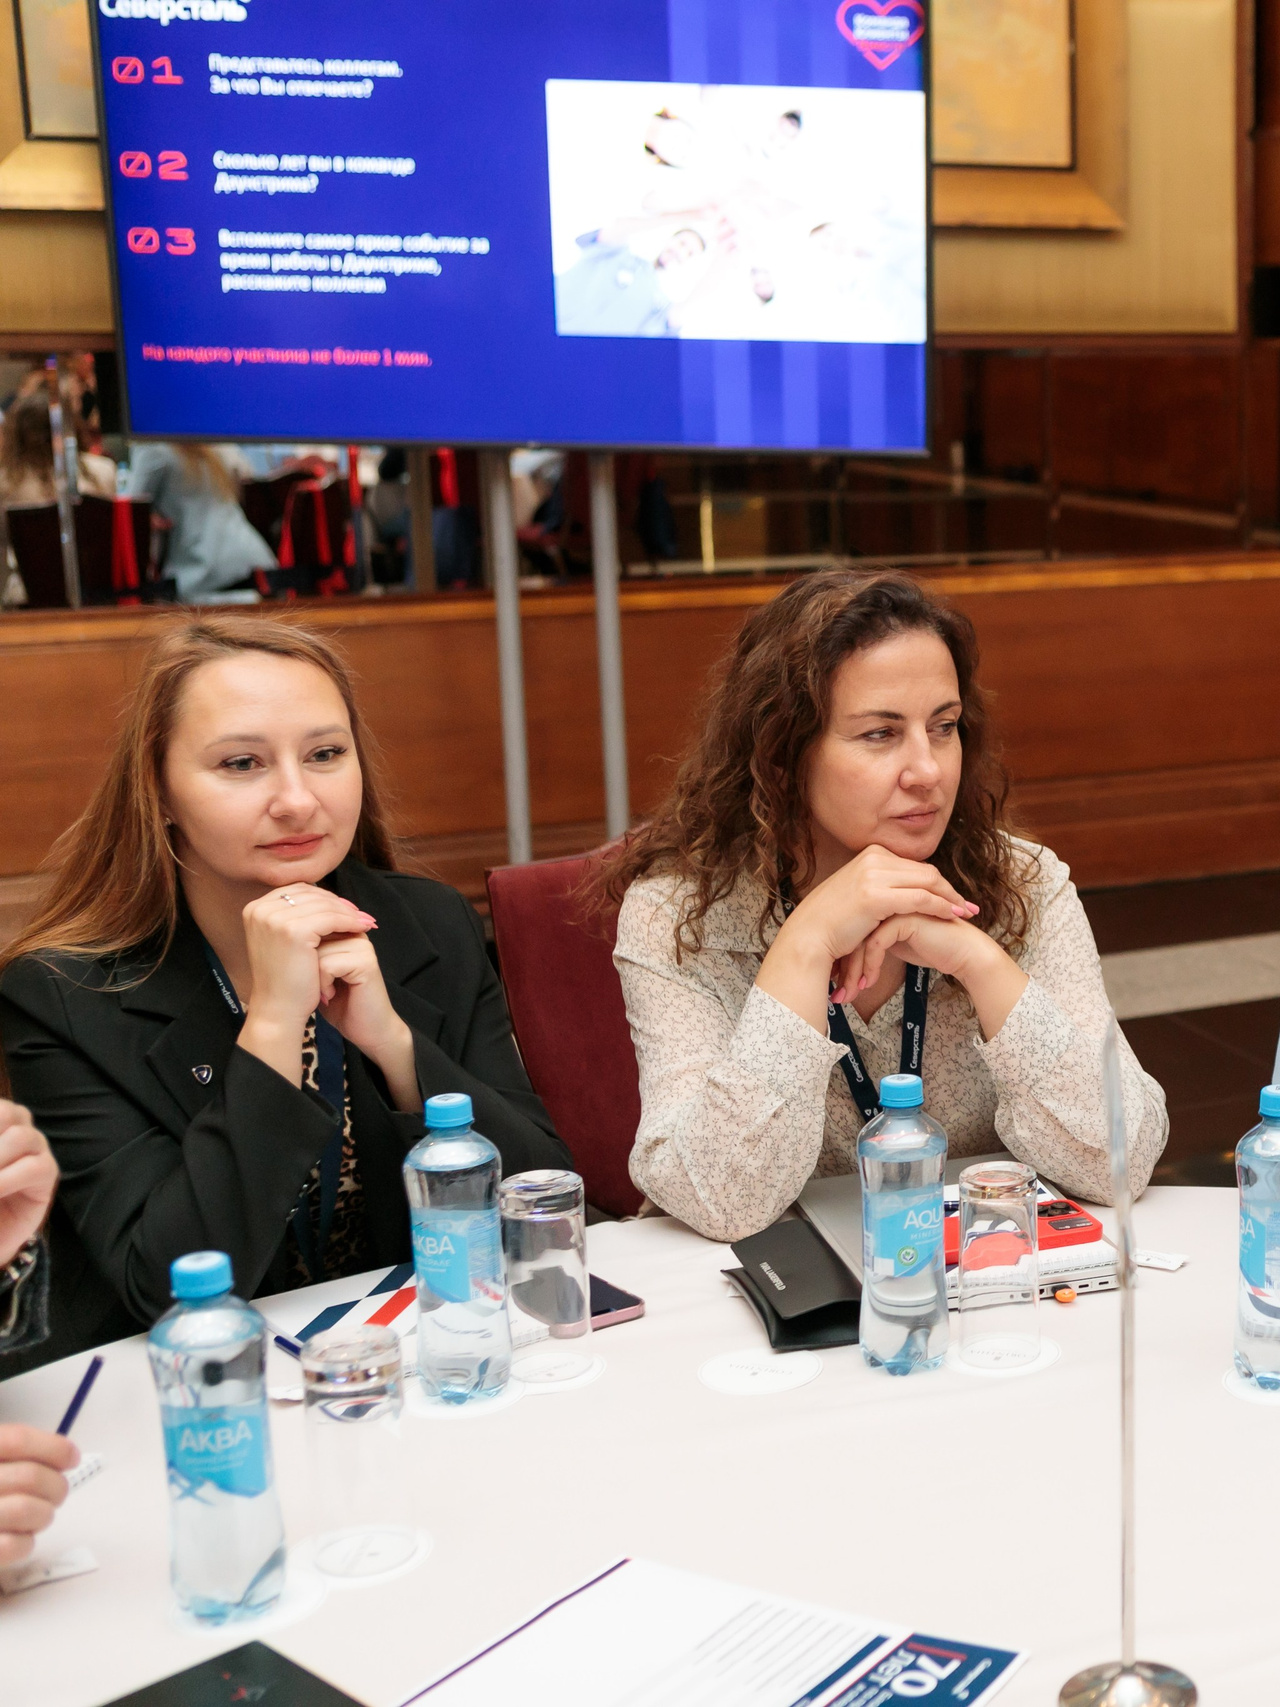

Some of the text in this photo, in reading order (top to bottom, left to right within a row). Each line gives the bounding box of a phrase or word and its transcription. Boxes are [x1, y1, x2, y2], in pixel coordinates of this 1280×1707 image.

[111, 56, 183, 84] 01
[231, 78, 260, 95] что
[119, 150, 189, 180] 02
[213, 150, 279, 170] Сколько
[279, 154, 308, 172] лет
[345, 156, 416, 177] команде
[127, 226, 196, 255] 03
[304, 233, 355, 250] самое
[355, 234, 403, 254] яркое
[403, 233, 469, 254] событие
[220, 252, 270, 272] время
[271, 251, 330, 273] работы
[142, 343, 165, 361] На
[166, 346, 232, 363] каждого
[232, 347, 310, 366] участника
[311, 349, 332, 365] не
[332, 346, 381, 366] более
[382, 347, 393, 367] 1
[909, 1024, 921, 1070] Северсталь
[180, 1420, 253, 1453] АКВА
[890, 1653, 962, 1698] 70
